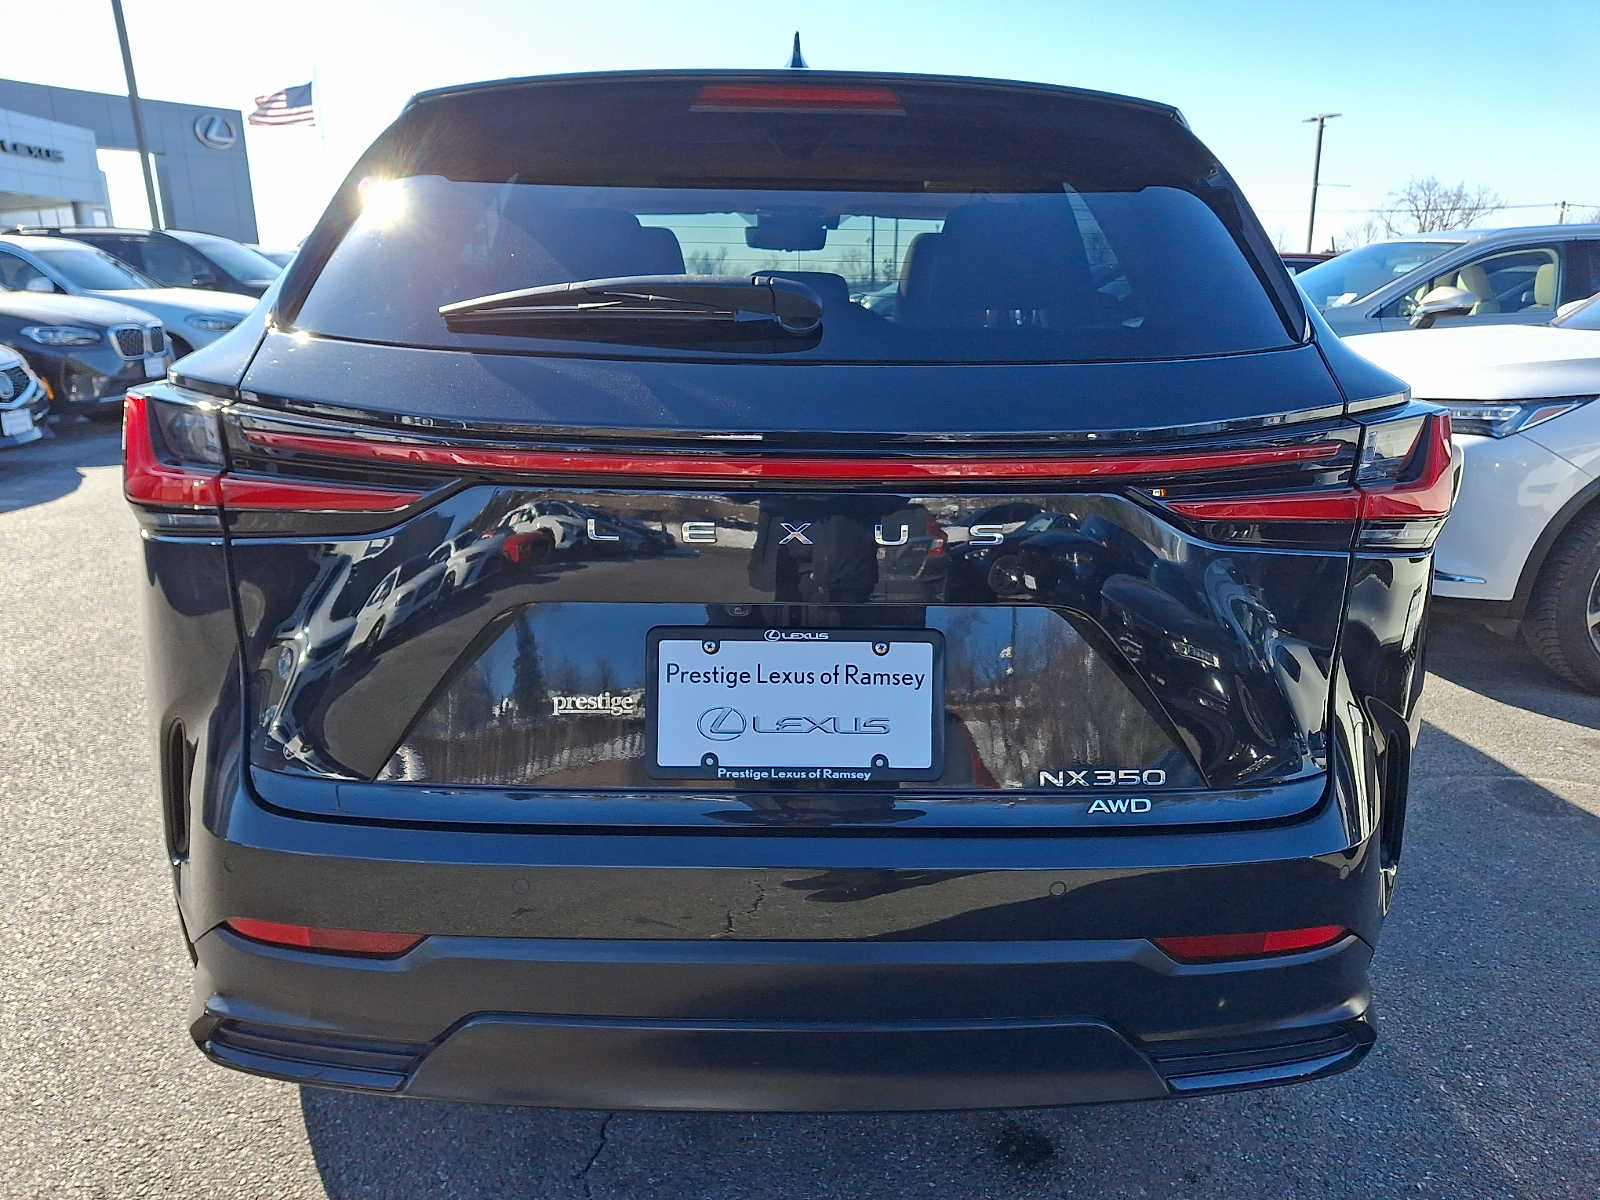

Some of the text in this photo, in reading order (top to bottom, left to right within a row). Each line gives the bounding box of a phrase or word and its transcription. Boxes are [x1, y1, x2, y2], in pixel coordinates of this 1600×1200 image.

[586, 519, 1004, 546] LEXUS
[782, 632, 829, 640] LEXUS
[666, 663, 925, 690] Prestige Lexus of Ramsey
[552, 692, 633, 716] prestige
[752, 715, 891, 735] LEXUS
[717, 767, 872, 781] Prestige Lexus of Ramsey
[1087, 798, 1152, 814] AWD
